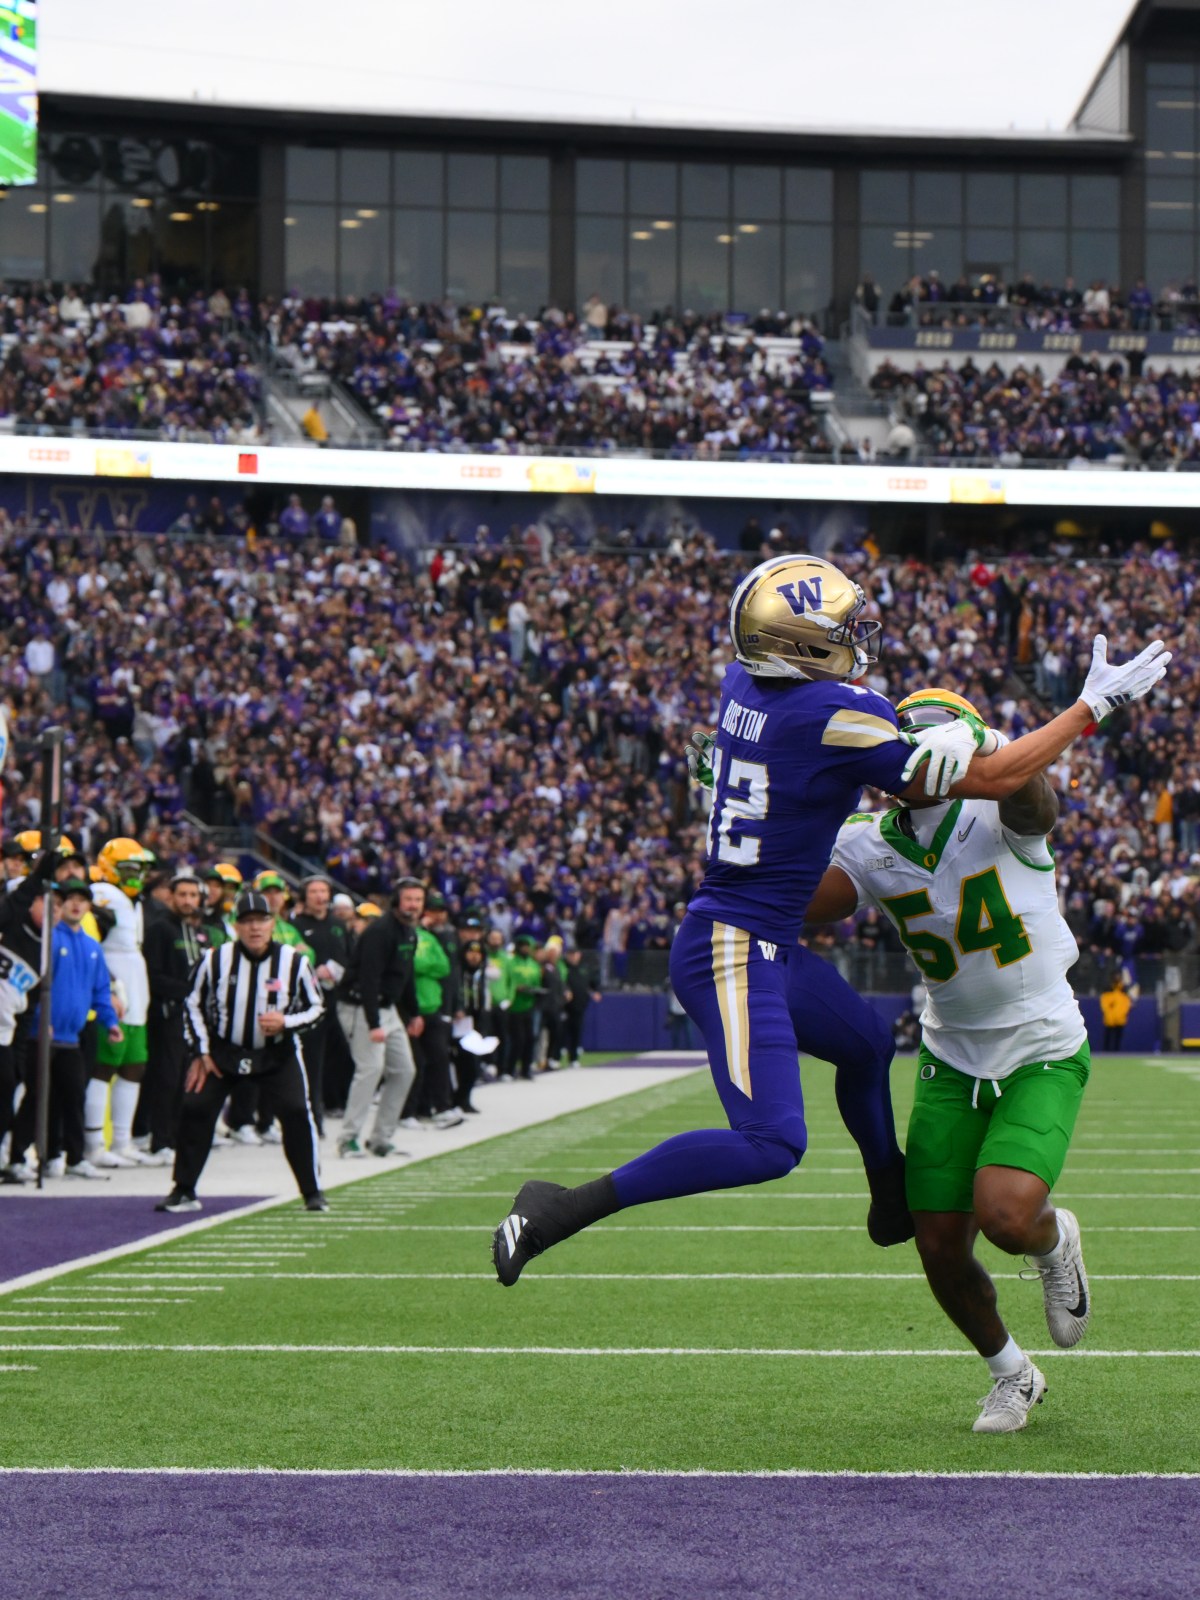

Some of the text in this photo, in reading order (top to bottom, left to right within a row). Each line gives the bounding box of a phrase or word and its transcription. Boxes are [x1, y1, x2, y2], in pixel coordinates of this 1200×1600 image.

[776, 576, 823, 617] W
[721, 699, 768, 743] BOSTON
[880, 865, 1033, 983] 54
[757, 940, 777, 961] W
[238, 1058, 252, 1075] S
